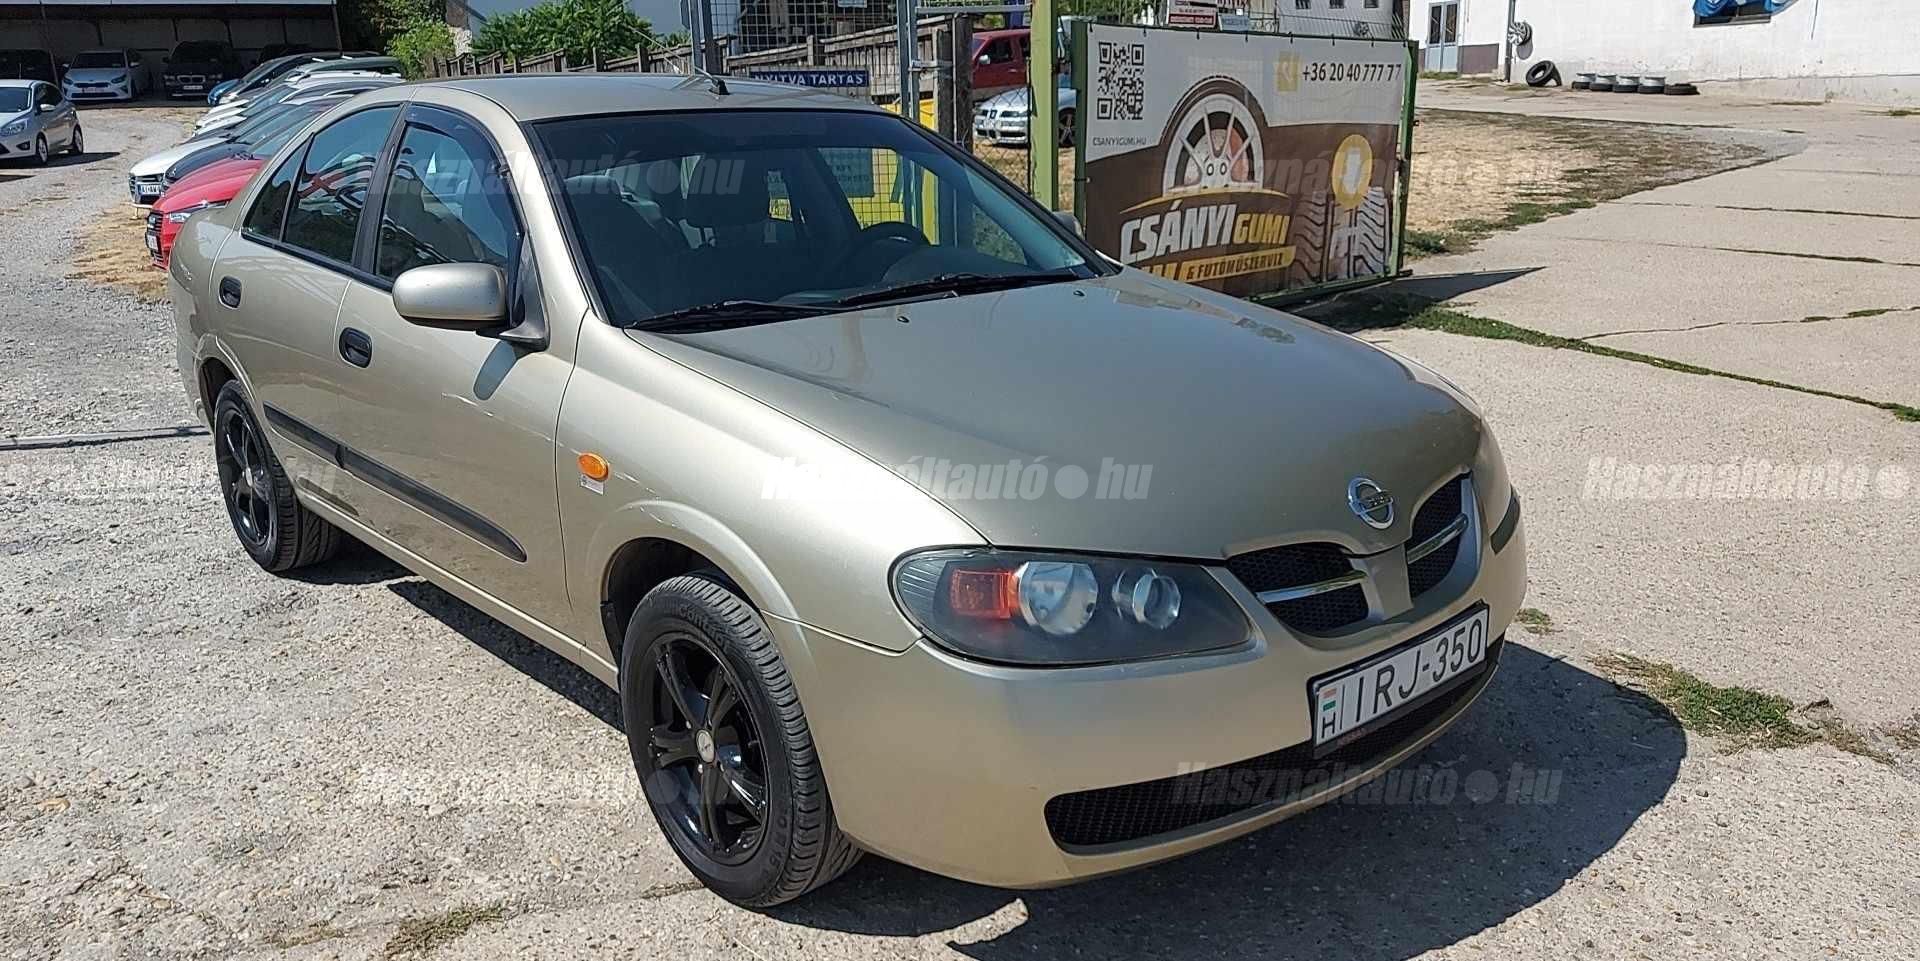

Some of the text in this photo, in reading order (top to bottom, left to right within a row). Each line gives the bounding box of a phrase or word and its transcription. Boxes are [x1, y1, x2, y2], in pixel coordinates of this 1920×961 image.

[1303, 62, 1401, 81] +36 20 40 777 77
[1355, 618, 1482, 723] IRJ-350
